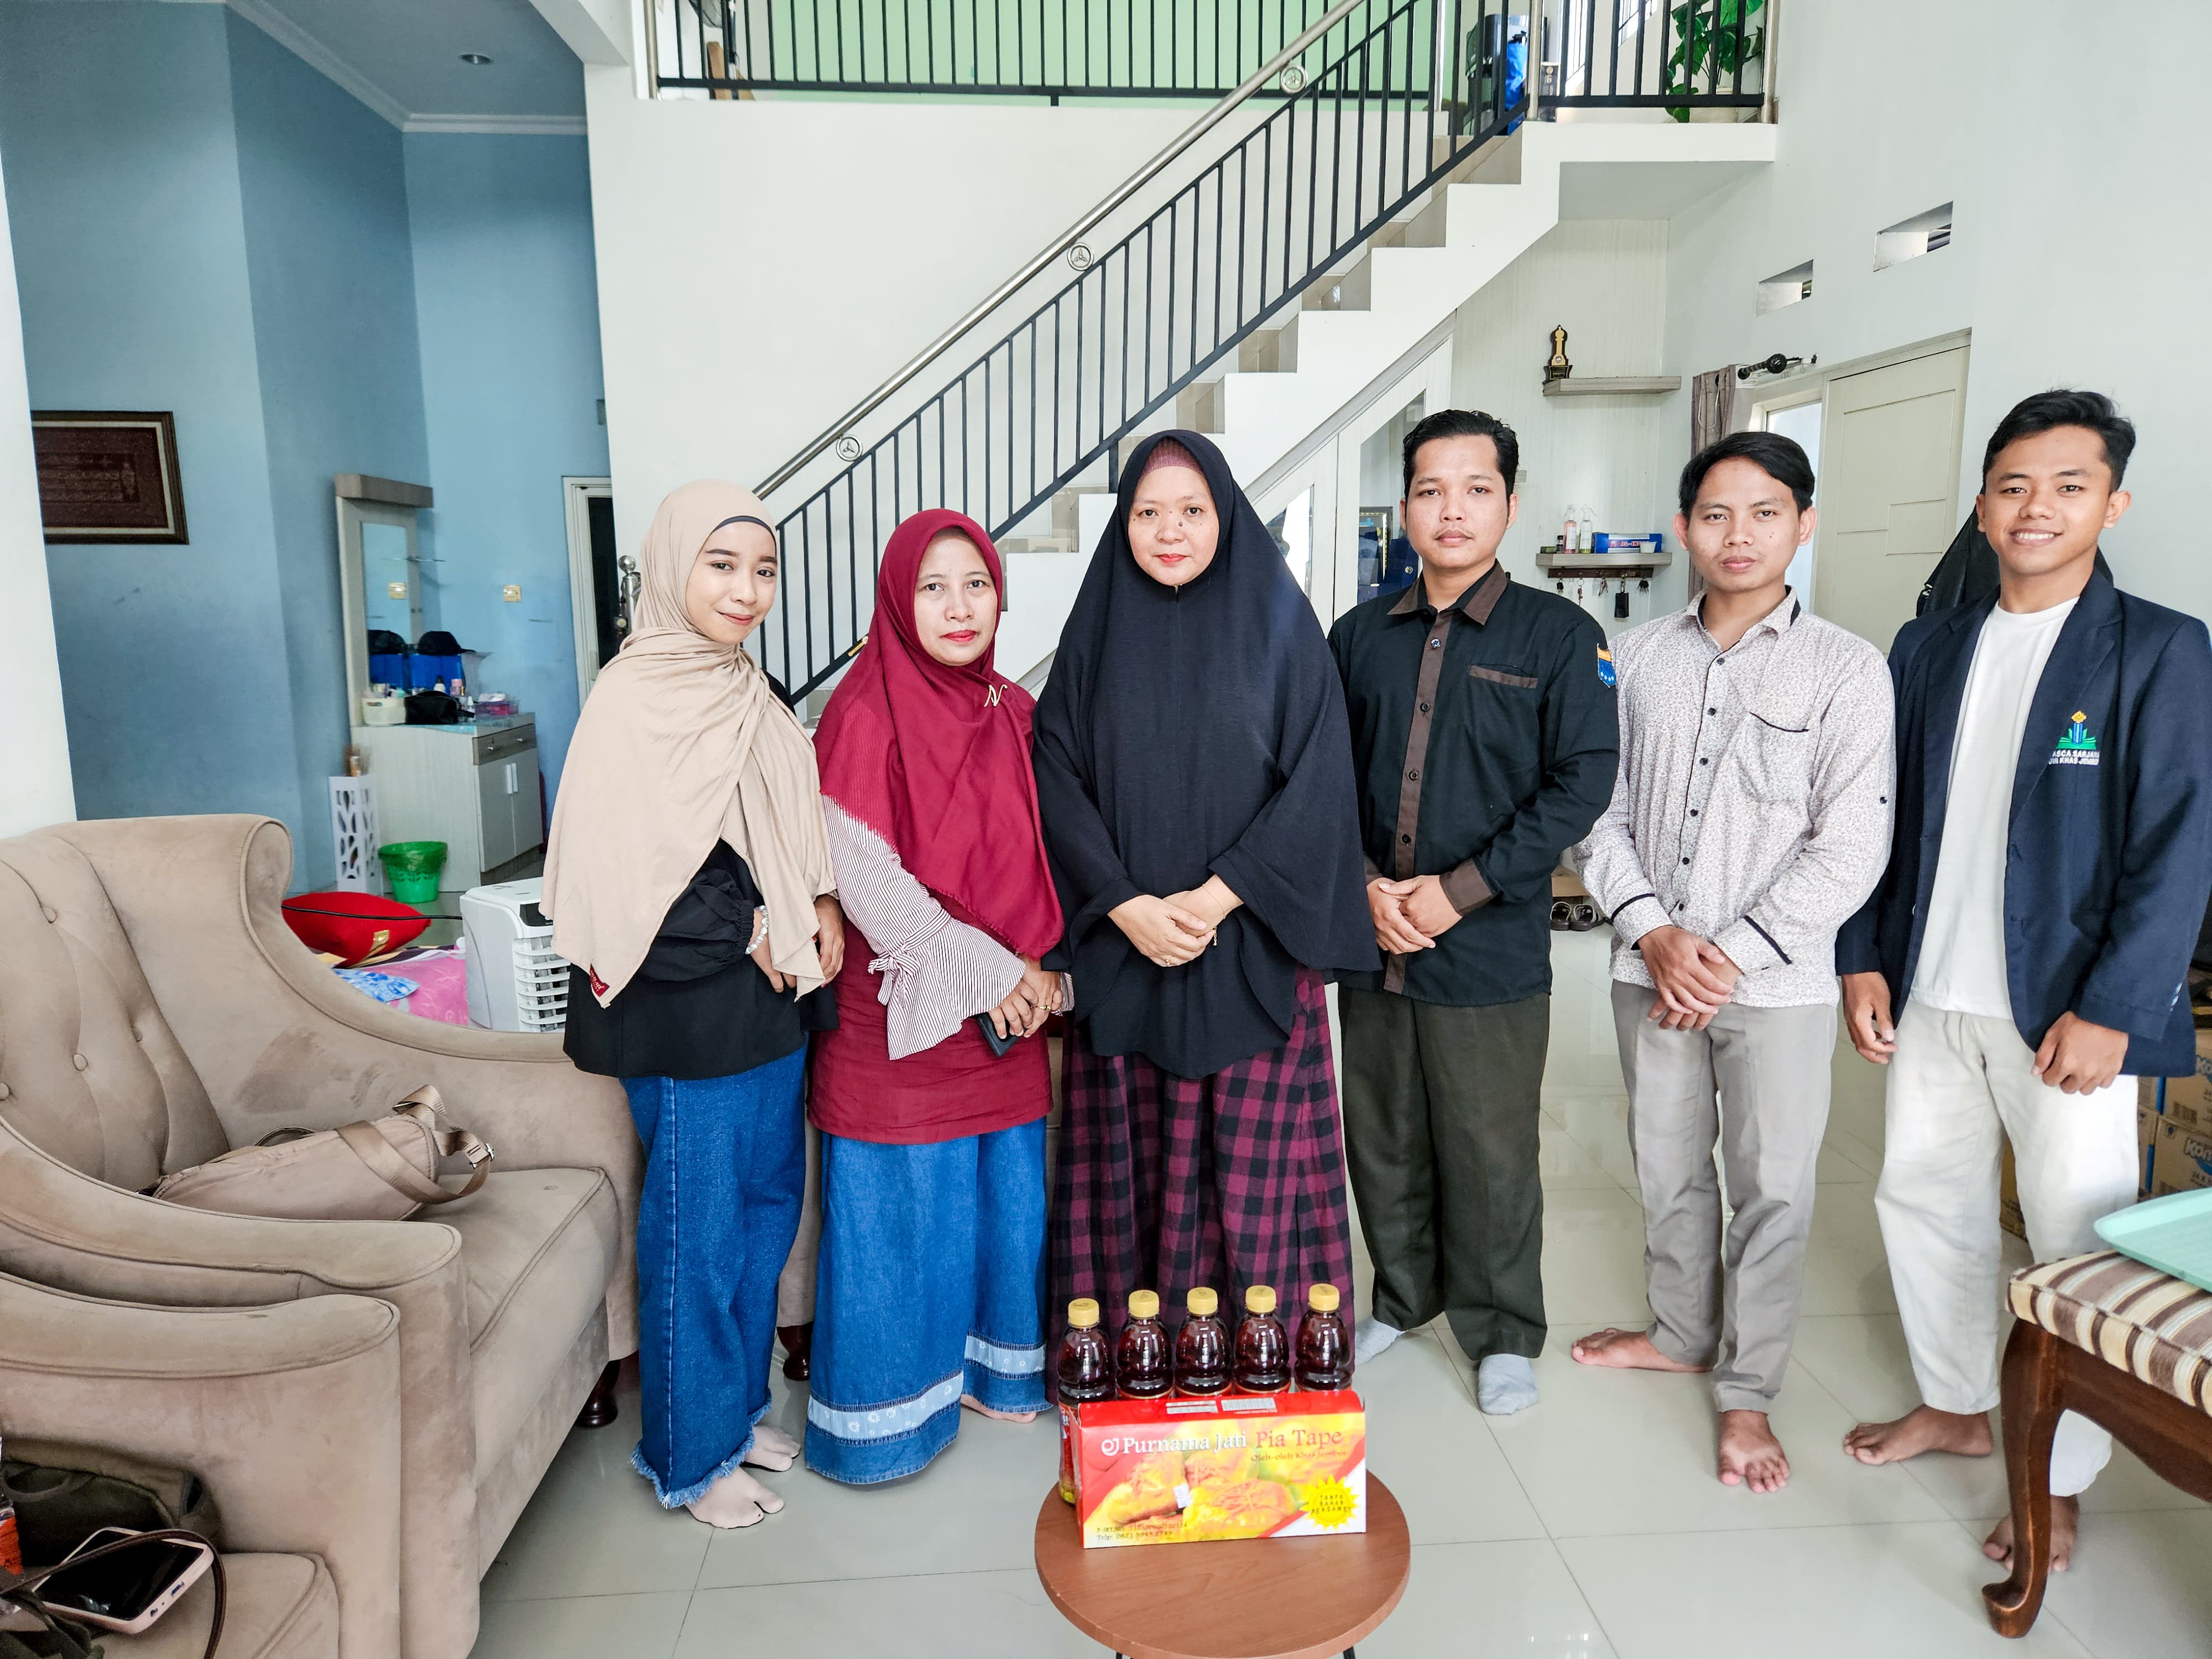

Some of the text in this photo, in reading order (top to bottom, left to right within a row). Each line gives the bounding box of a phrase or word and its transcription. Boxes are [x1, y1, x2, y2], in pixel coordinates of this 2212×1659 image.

[1123, 1429, 1342, 1454] Purnama Jati Pia Tape
